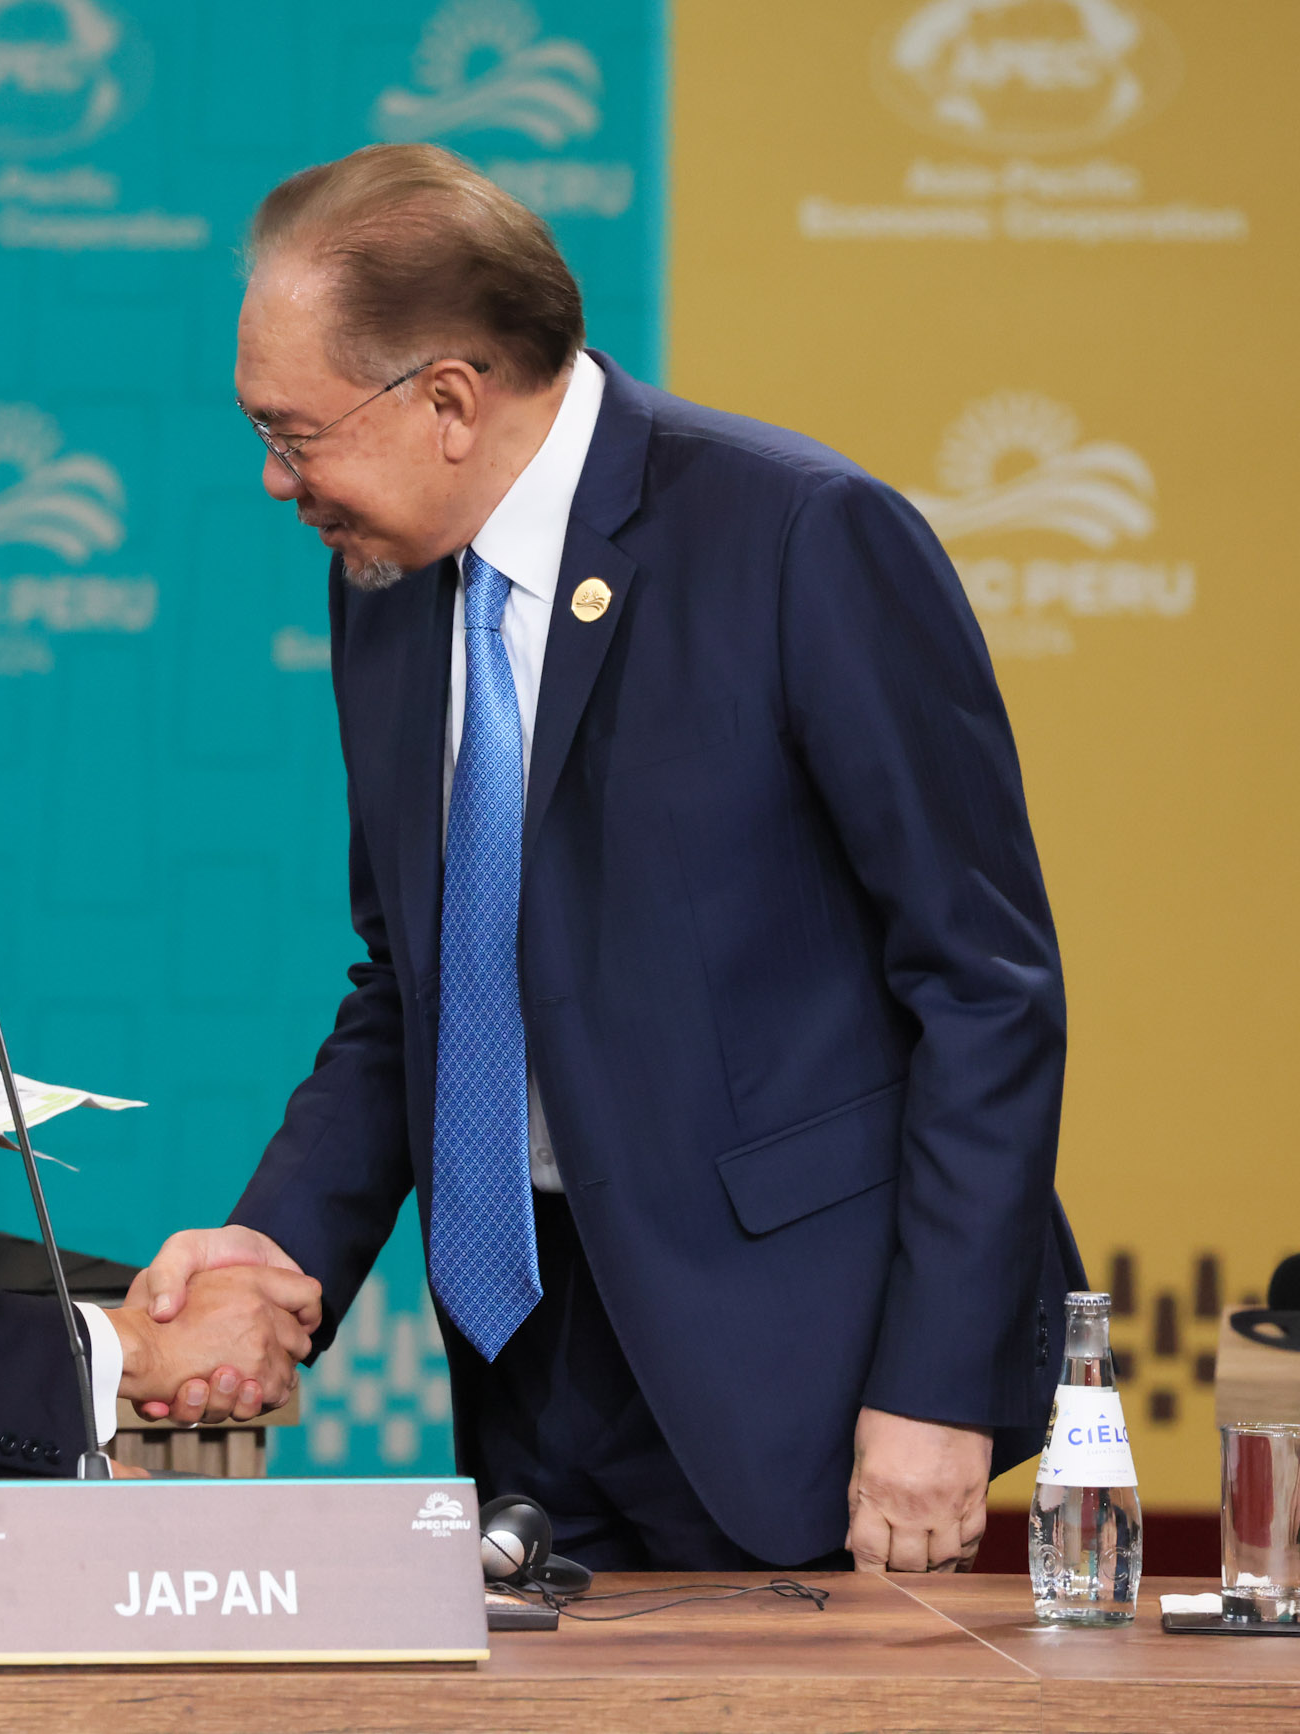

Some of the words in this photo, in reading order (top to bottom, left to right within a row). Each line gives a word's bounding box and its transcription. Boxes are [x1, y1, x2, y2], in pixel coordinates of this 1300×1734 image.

[1023, 562, 1197, 618] PERU
[411, 1519, 441, 1531] APEC
[442, 1519, 471, 1531] PERU
[113, 1570, 299, 1617] JAPAN
